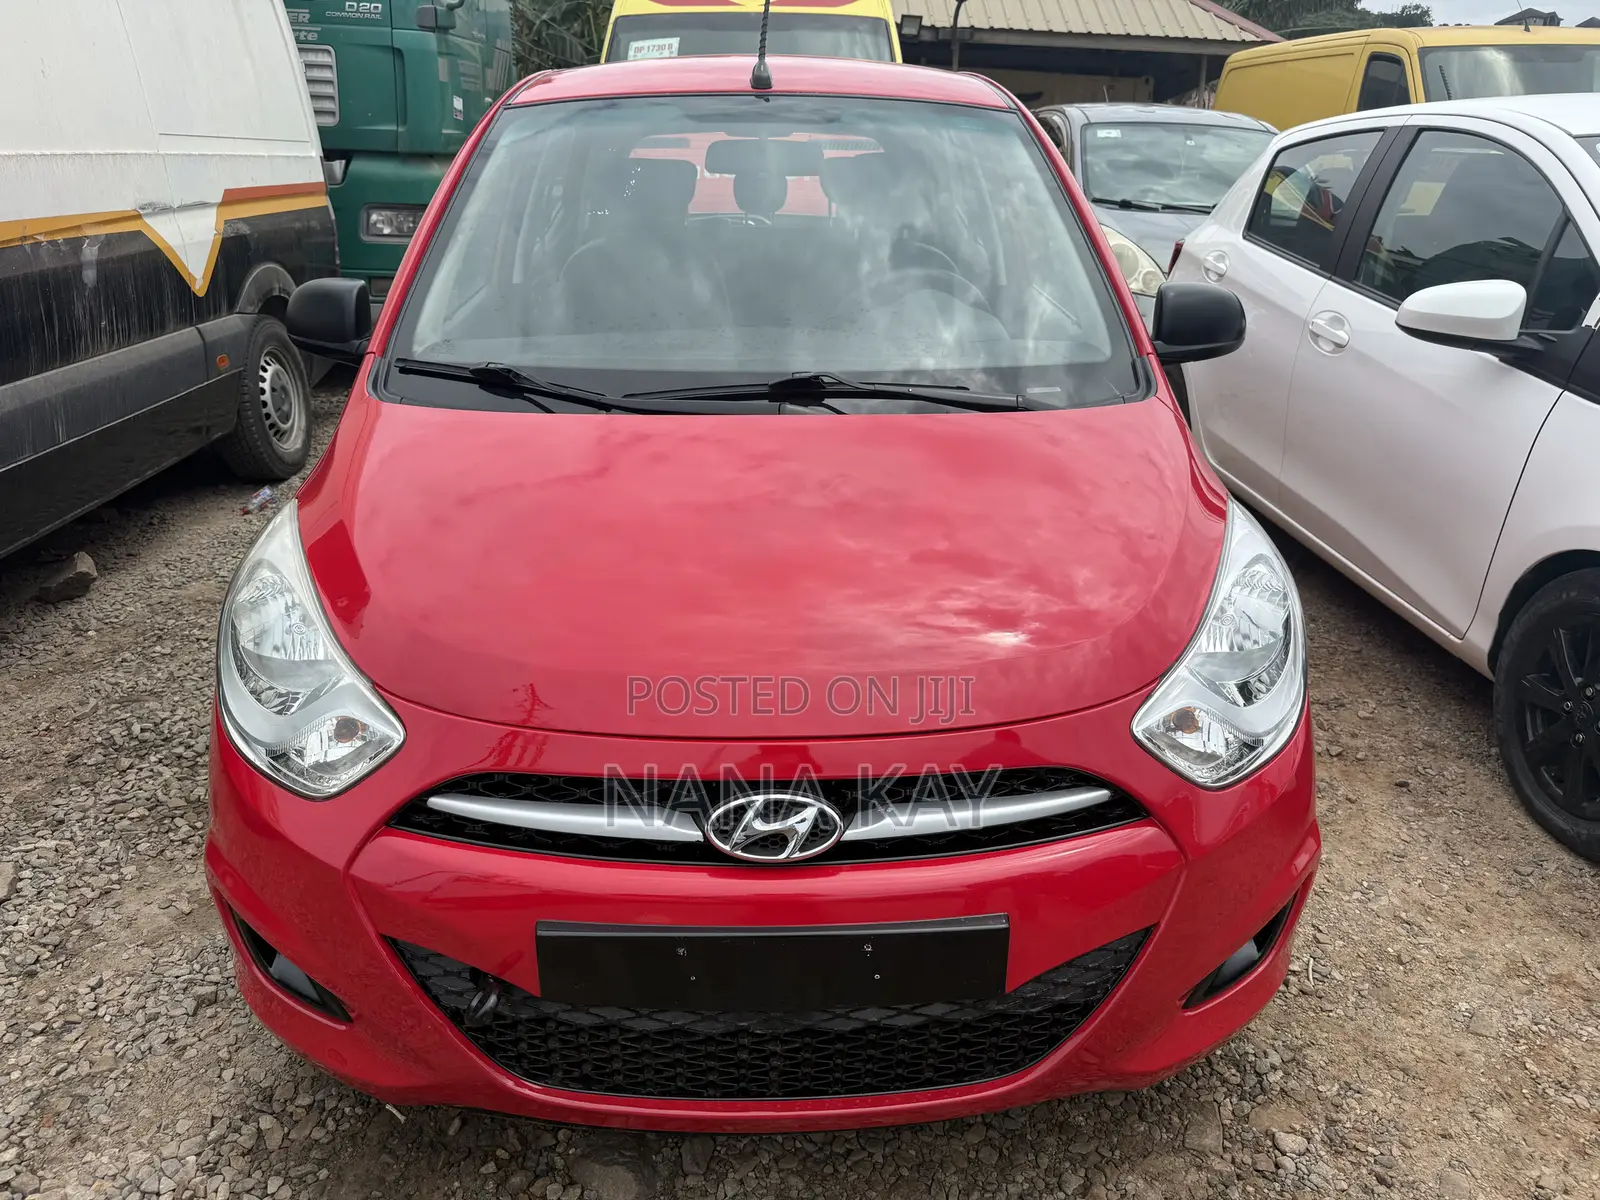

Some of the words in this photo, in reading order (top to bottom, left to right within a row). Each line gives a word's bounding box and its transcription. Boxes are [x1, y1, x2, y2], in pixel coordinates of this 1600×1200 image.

[325, 11, 363, 19] COMMON
[634, 46, 645, 54] DP
[647, 43, 667, 53] 1730
